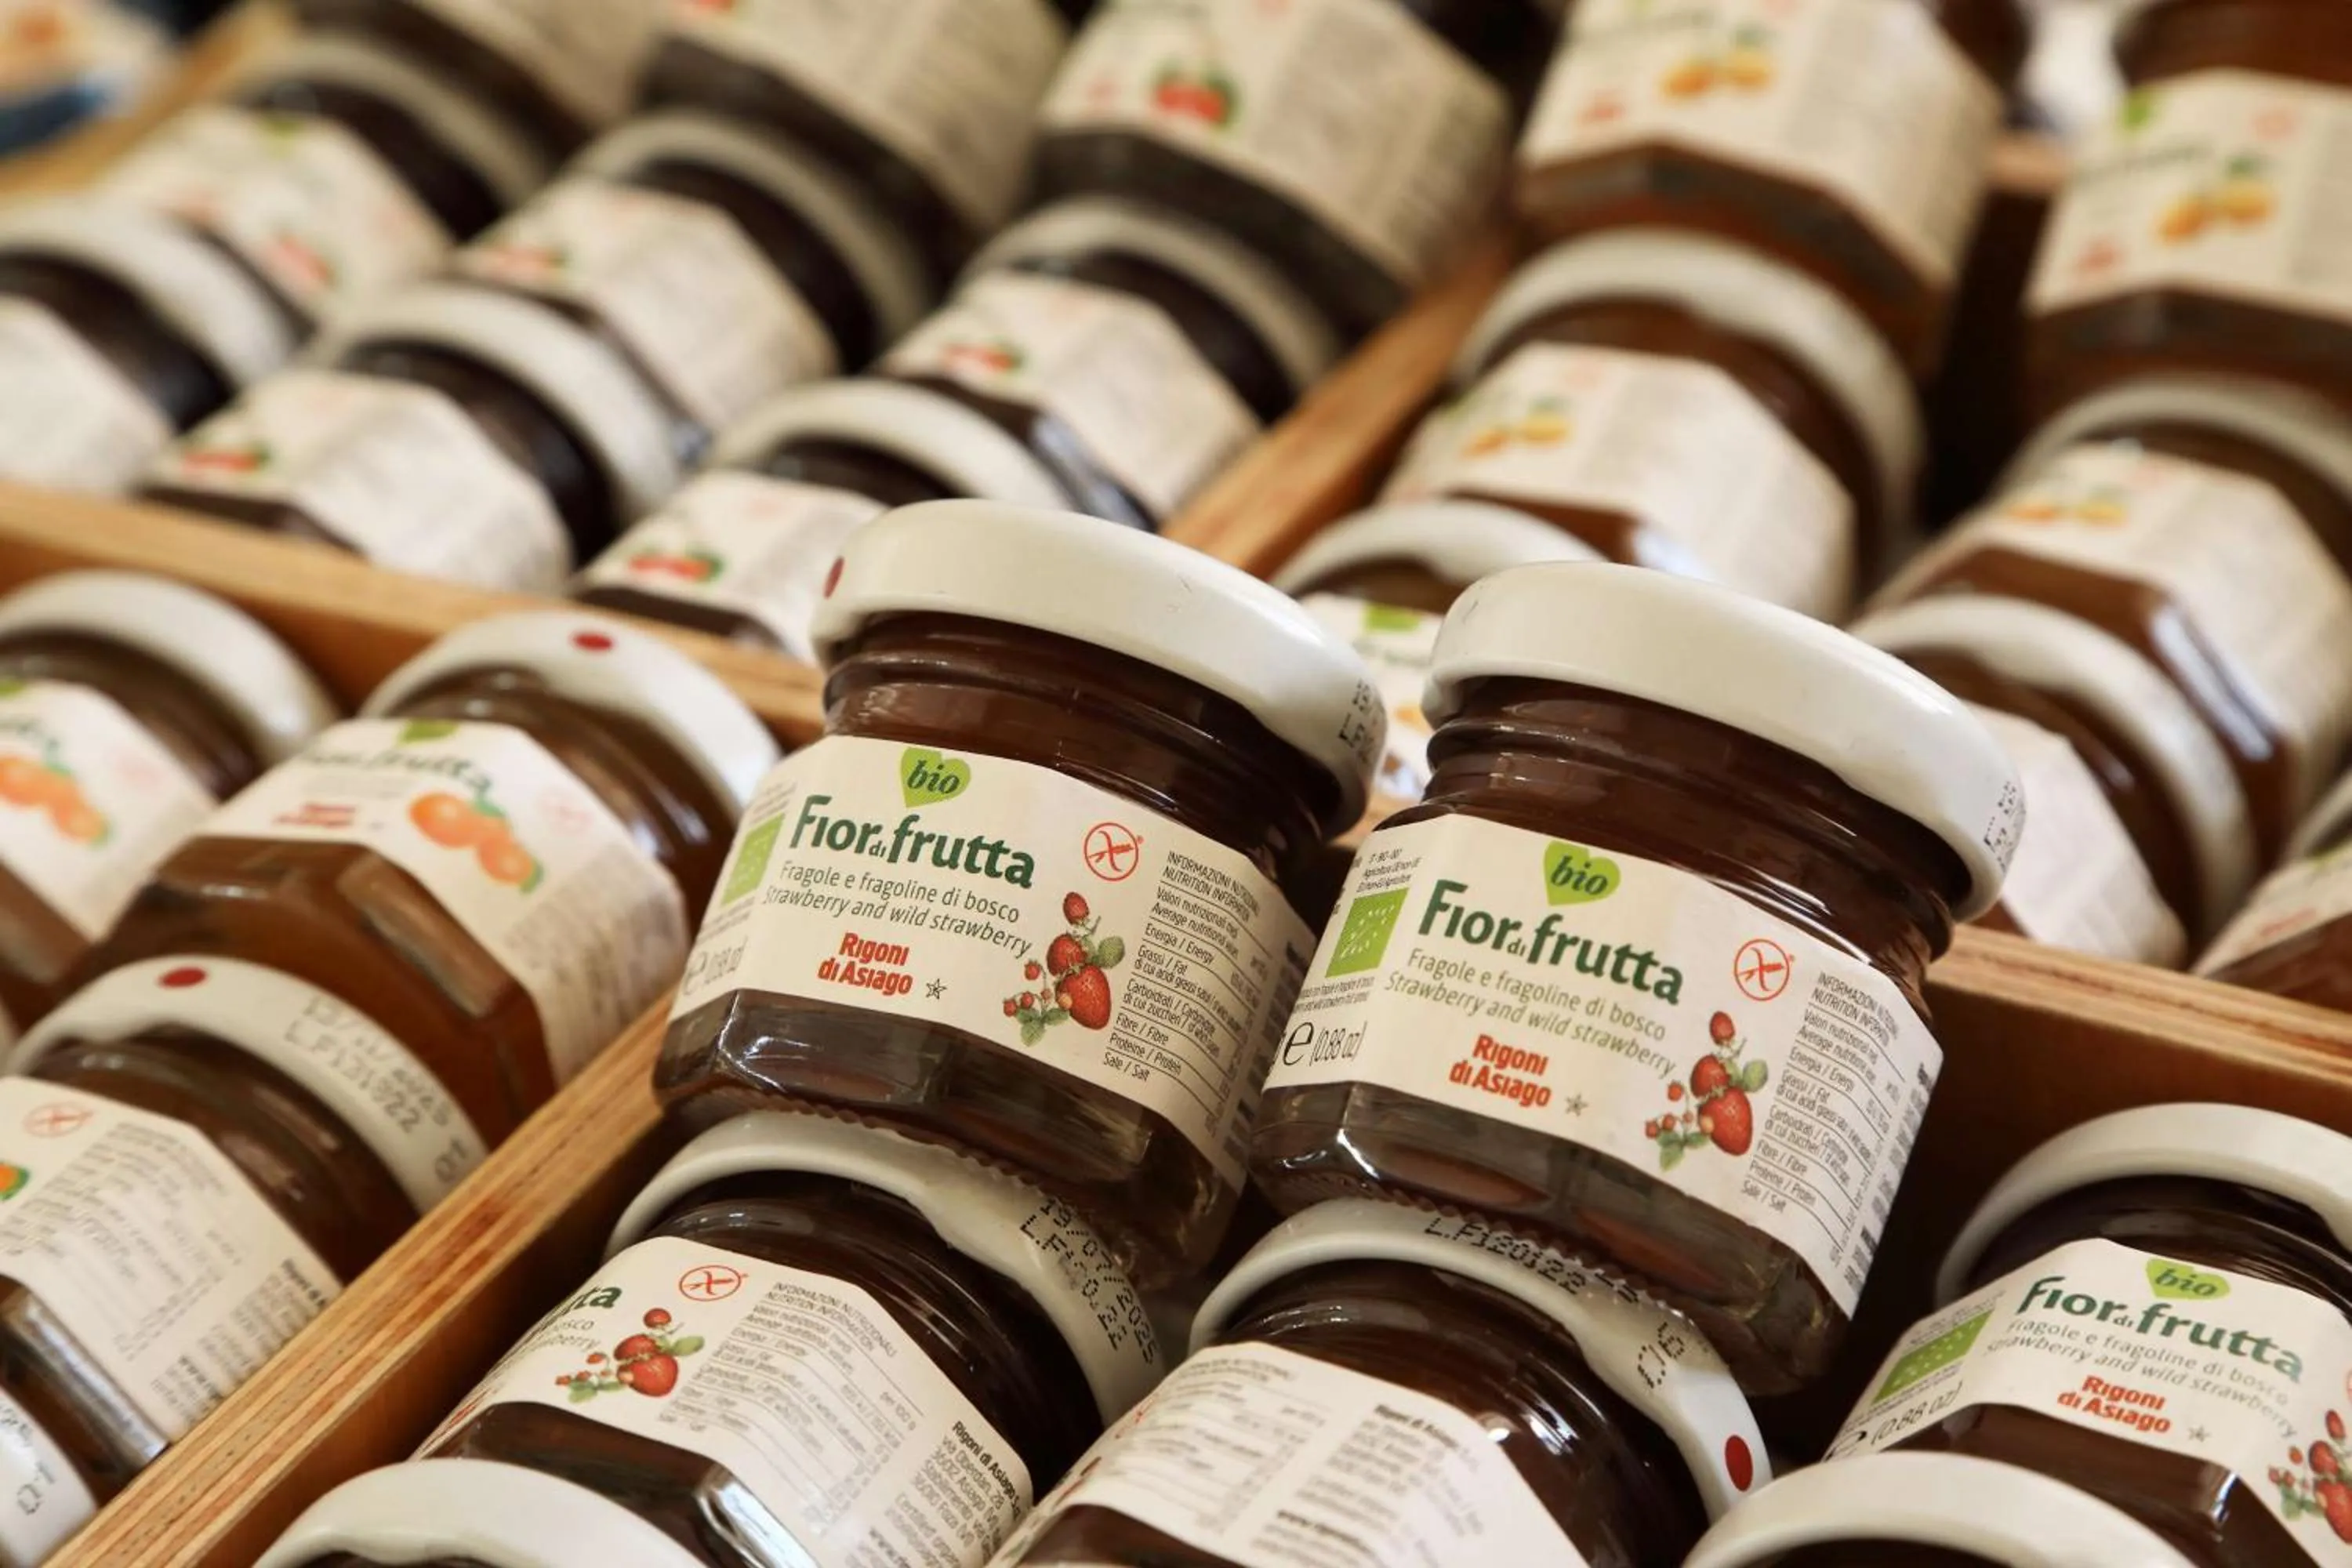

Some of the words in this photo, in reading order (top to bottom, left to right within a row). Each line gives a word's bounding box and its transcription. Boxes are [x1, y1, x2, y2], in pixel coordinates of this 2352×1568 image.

[907, 759, 960, 796] bio
[789, 794, 884, 852] Fior
[887, 815, 1035, 889] frutta
[781, 861, 841, 892] Fragole
[845, 876, 855, 889] e
[859, 872, 938, 904] fragoline
[942, 884, 960, 907] di
[965, 891, 1020, 924] bosco
[1163, 866, 1212, 899] NUTRITION
[1550, 855, 1608, 895] bio
[851, 900, 888, 920] and
[890, 906, 929, 927] wild
[930, 915, 1033, 959] strawberry
[1152, 902, 1186, 926] Average
[839, 932, 910, 967] Rigoni
[1138, 945, 1164, 966] Grassi
[1174, 959, 1189, 975] Fat
[1145, 923, 1178, 946] Energia
[1186, 939, 1216, 965] Energy
[1418, 879, 1523, 950] Fior
[1526, 913, 1684, 1006] frutta
[818, 956, 840, 982] di
[839, 966, 914, 996] Asiago
[1407, 948, 1475, 983] Fragole
[1480, 972, 1492, 988] e
[1496, 970, 1581, 1012] fragoline
[1585, 993, 1605, 1016] di
[1609, 1003, 1666, 1042] bosco
[1384, 972, 1484, 1017] Strawberry
[1486, 998, 1526, 1023] and
[1527, 1007, 1570, 1037] wild
[1571, 1021, 1678, 1080] strawberry
[1103, 1052, 1123, 1070] Sale
[1131, 1065, 1151, 1082] Salt
[1472, 1033, 1550, 1076] Rigoni
[1449, 1060, 1474, 1085] di
[1472, 1068, 1552, 1109] Asiago
[2154, 1269, 2219, 1296] bio
[2136, 1302, 2303, 1384] frutta
[2085, 1333, 2098, 1345] e
[2103, 1333, 2197, 1369] fragoline
[2203, 1357, 2224, 1377] di
[2229, 1367, 2289, 1406] bosco
[2057, 1391, 2082, 1410] di
[2082, 1397, 2172, 1435] Asiago
[2082, 1374, 2167, 1411] Rigoni
[2094, 1352, 2136, 1374] and
[2140, 1363, 2188, 1386] wild
[2188, 1375, 2298, 1440] strawberry
[952, 1420, 984, 1457] Rigoni
[988, 1462, 1018, 1501] Asiago
